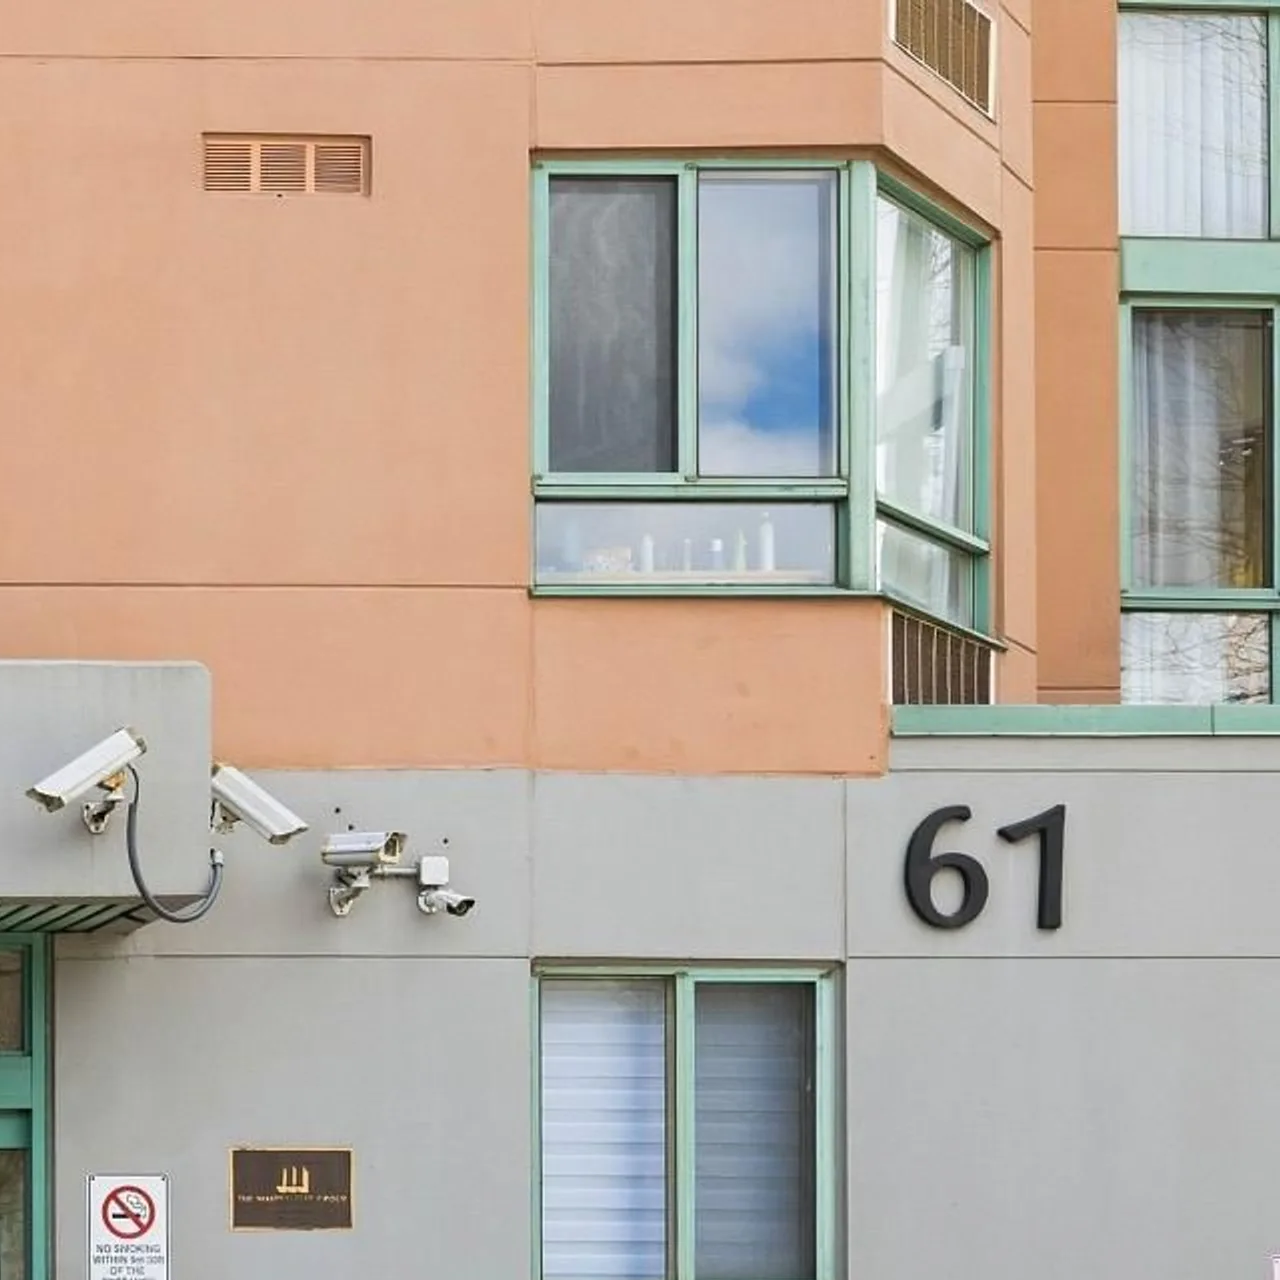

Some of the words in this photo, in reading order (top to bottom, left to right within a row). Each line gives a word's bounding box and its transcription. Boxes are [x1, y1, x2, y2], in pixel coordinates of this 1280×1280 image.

[903, 804, 1066, 930] 61
[96, 1243, 111, 1253] NO
[114, 1243, 161, 1253] SMOKING
[110, 1266, 124, 1275] OF
